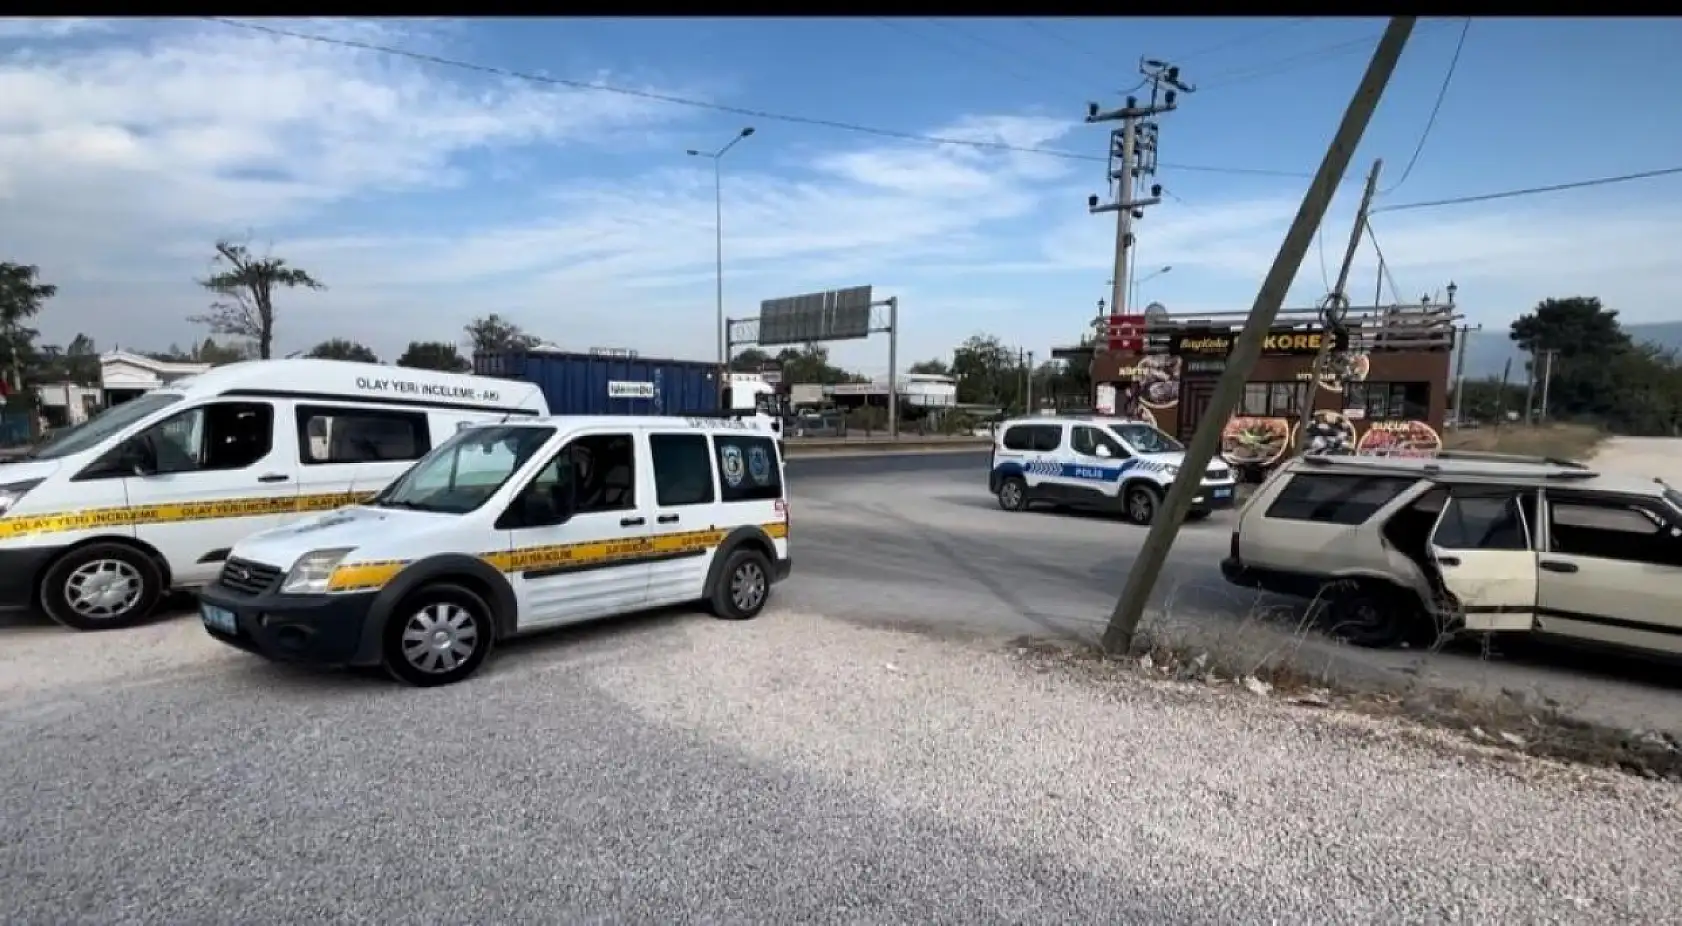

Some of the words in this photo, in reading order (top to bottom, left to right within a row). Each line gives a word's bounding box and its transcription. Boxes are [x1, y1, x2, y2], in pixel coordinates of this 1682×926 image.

[355, 376, 389, 391] OLAY
[180, 505, 213, 518] OLAY
[12, 518, 51, 533] OLAY
